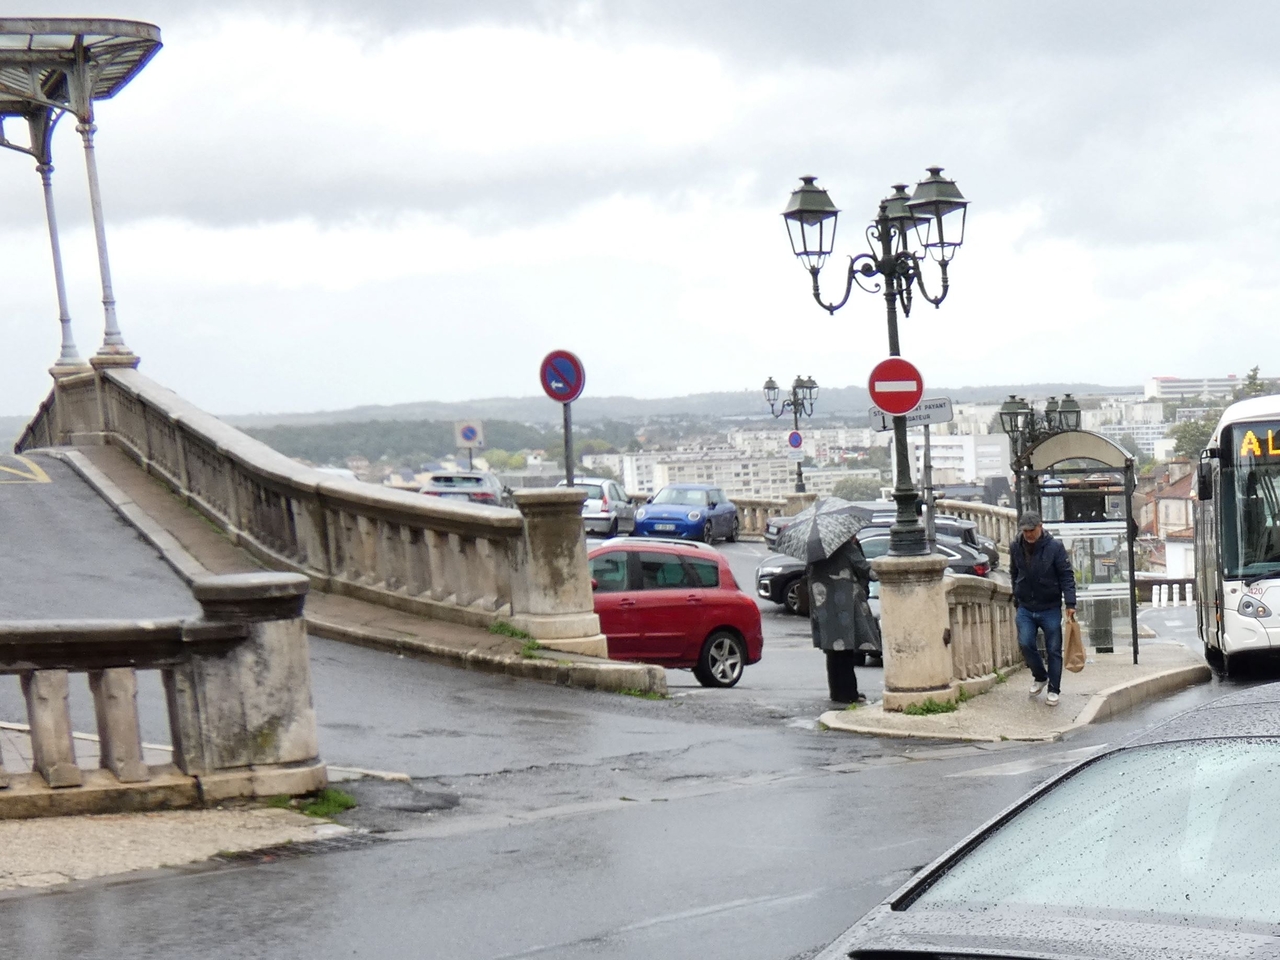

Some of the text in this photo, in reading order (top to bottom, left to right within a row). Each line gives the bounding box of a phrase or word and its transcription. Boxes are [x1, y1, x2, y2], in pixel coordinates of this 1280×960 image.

[924, 402, 946, 410] PAYANT
[905, 413, 931, 422] DATEUR
[1241, 430, 1261, 456] A
